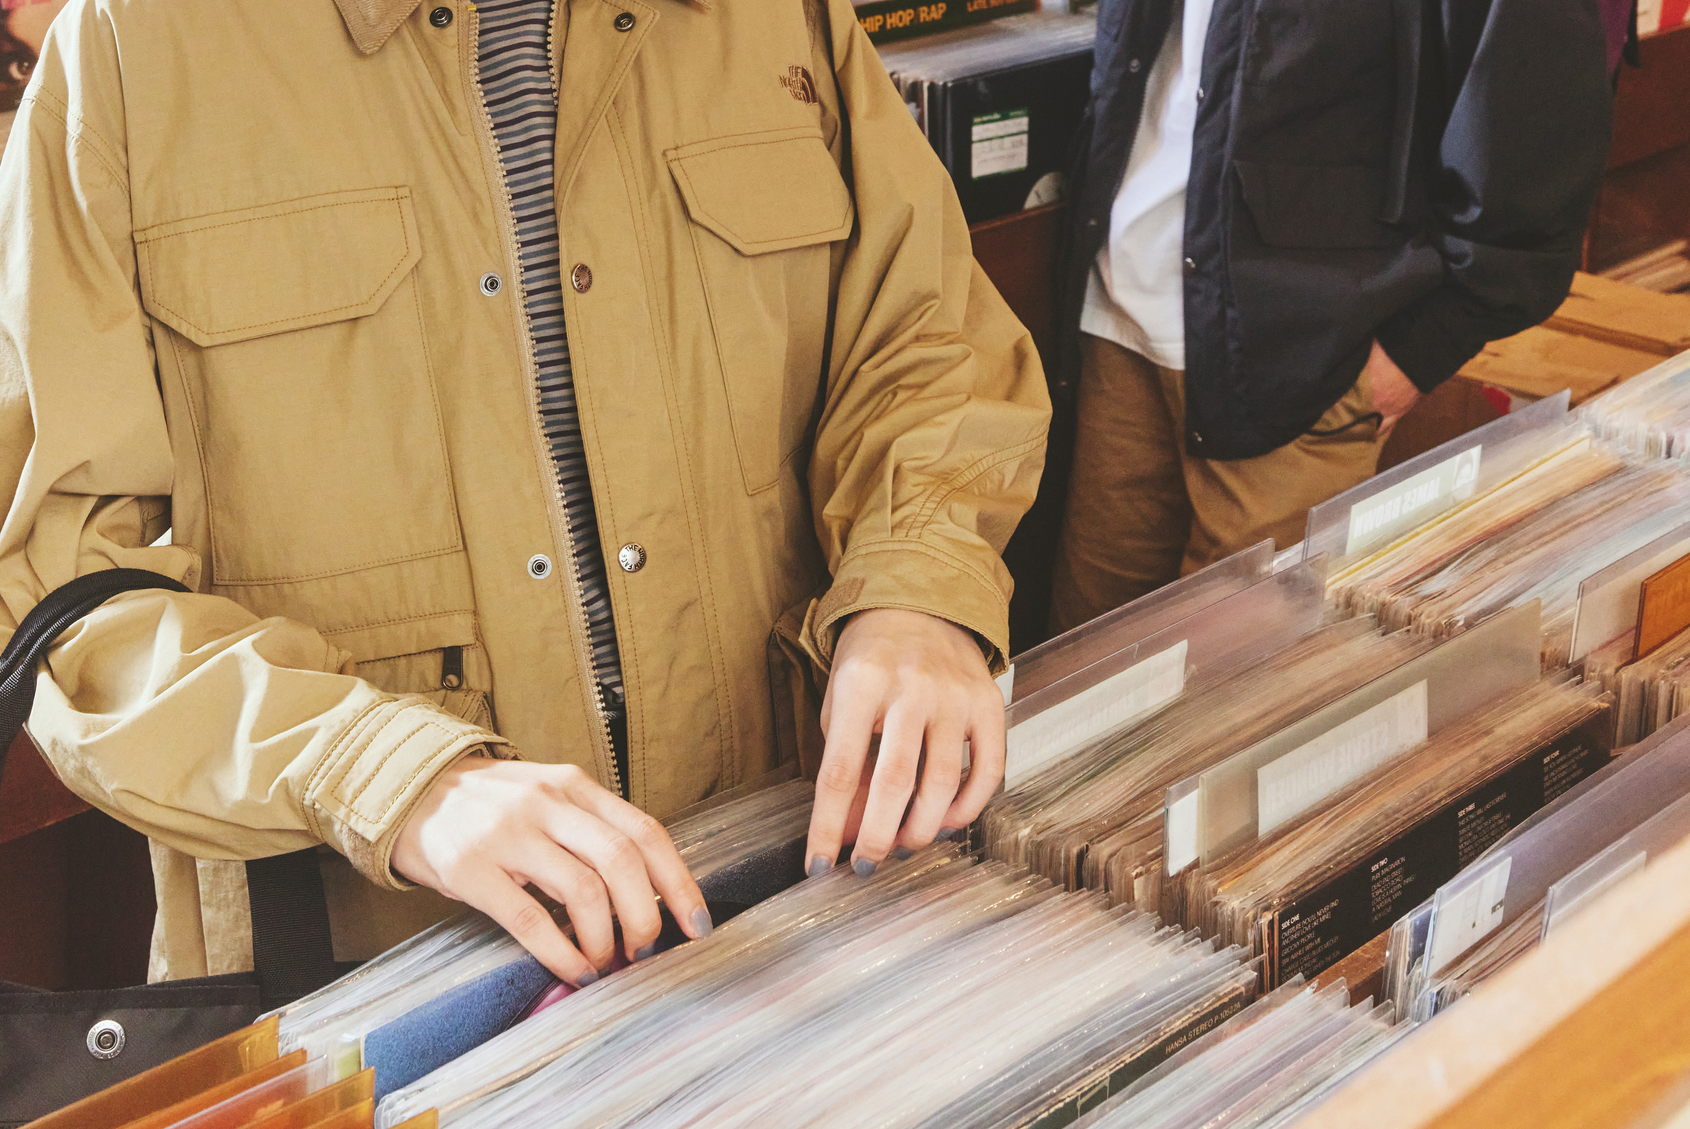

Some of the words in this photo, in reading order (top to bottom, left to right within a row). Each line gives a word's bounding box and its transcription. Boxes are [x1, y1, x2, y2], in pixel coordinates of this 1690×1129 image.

[860, 14, 884, 33] HIP
[625, 544, 638, 552] THE
[634, 548, 646, 570] NORTH
[1371, 863, 1379, 872] SIDE
[1380, 858, 1388, 867] TWO
[1282, 922, 1301, 940] OVERTURE
[1317, 905, 1330, 916] NEVER
[1330, 898, 1339, 909] FIND
[1282, 919, 1290, 930] SIDE
[1291, 913, 1300, 924] ONE
[1282, 931, 1300, 946] ANOTHER
[1301, 924, 1311, 935] LOVE
[1282, 941, 1300, 957] GROOVY
[1300, 931, 1315, 945] PEOPLE
[1166, 1035, 1187, 1055] HANSA
[1188, 1018, 1214, 1040] STEREO
